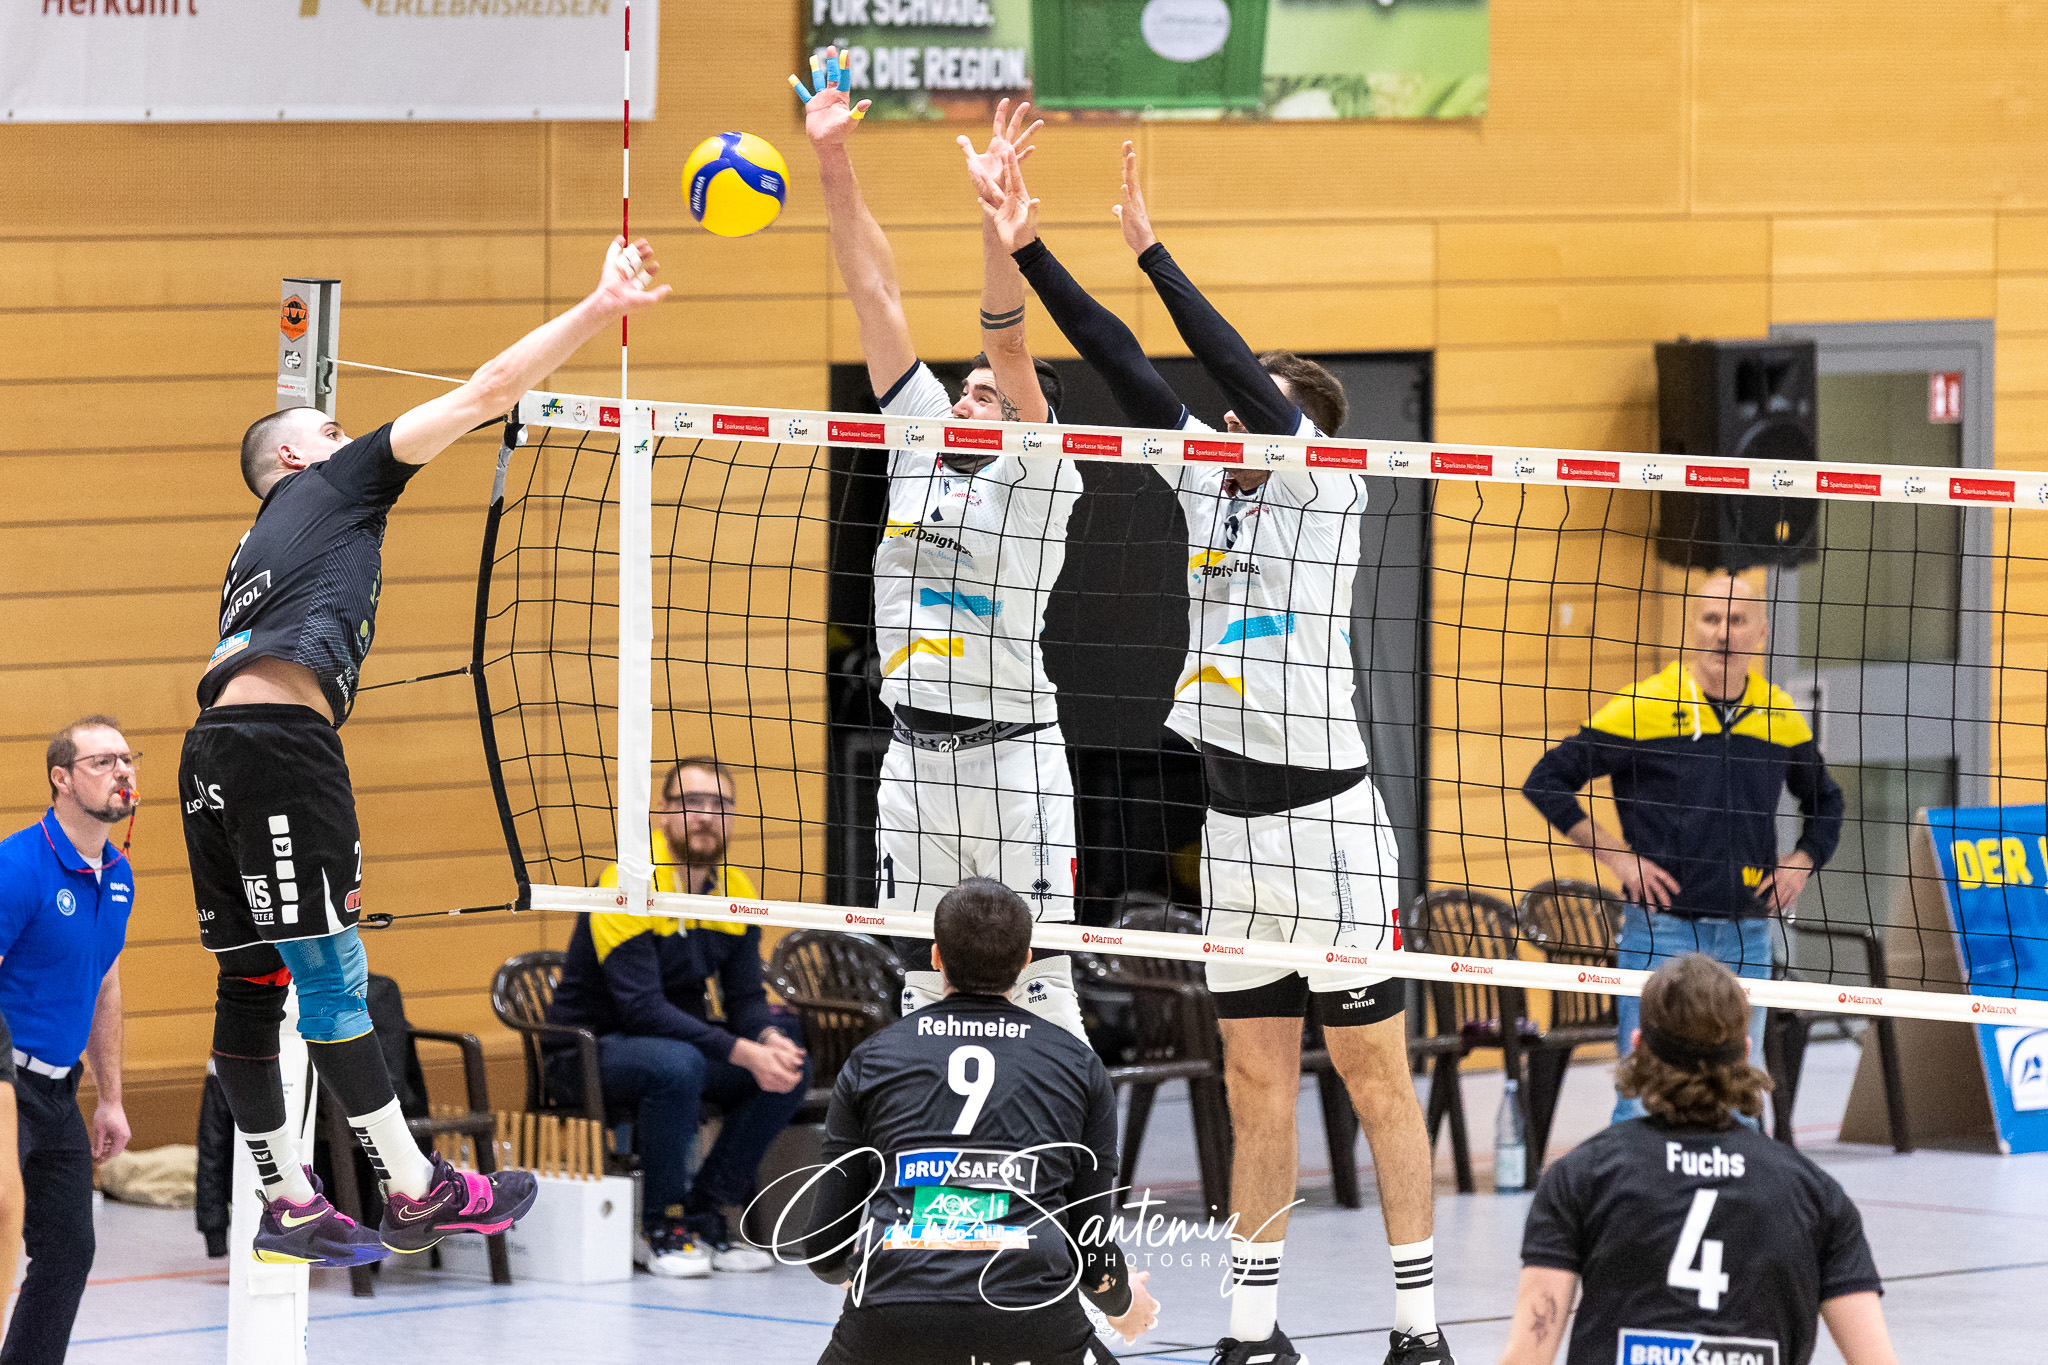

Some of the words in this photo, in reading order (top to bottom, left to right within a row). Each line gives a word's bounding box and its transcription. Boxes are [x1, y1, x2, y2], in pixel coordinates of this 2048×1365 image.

[873, 47, 920, 88] DIE
[924, 47, 1032, 89] REGION.
[680, 421, 693, 429] Zapf
[724, 423, 745, 431] Sparkasse
[794, 428, 807, 436] Zapf
[911, 434, 924, 442] Zapf
[1028, 440, 1042, 448] Zapf
[1148, 447, 1162, 455] Zapf
[1270, 453, 1285, 461] Zapf
[1318, 455, 1341, 463] Sparkasse
[1394, 459, 1409, 467] Zapf
[1443, 461, 1466, 469] Sparkasse
[1520, 466, 1535, 474] Zapf
[1648, 472, 1663, 480] Zapf
[1698, 474, 1722, 482] Sparkasse
[1778, 479, 1793, 487] Zapf
[1829, 481, 1853, 489] Sparkasse
[1910, 485, 1925, 493] Zapf
[1962, 487, 1986, 495] Sparkasse
[1951, 837, 2033, 889] DER
[738, 904, 769, 916] Marmot
[854, 914, 885, 925] Marmot
[1090, 933, 1123, 946] Marmot
[1211, 943, 1244, 955] Marmot
[1335, 953, 1368, 965] Marmot
[1460, 963, 1494, 974] Marmot
[1587, 973, 1621, 985] Marmot
[1342, 998, 1375, 1010] erima
[1848, 993, 1883, 1005] Marmot
[1981, 1002, 2017, 1016] Marmot
[917, 1014, 1031, 1039] Rehmeier
[946, 1045, 996, 1136] 9
[1666, 1142, 1745, 1178] Fuchs
[904, 1160, 1026, 1182] BRUXSAFOL
[924, 1193, 979, 1218] AOK
[1667, 1189, 1730, 1311] 4
